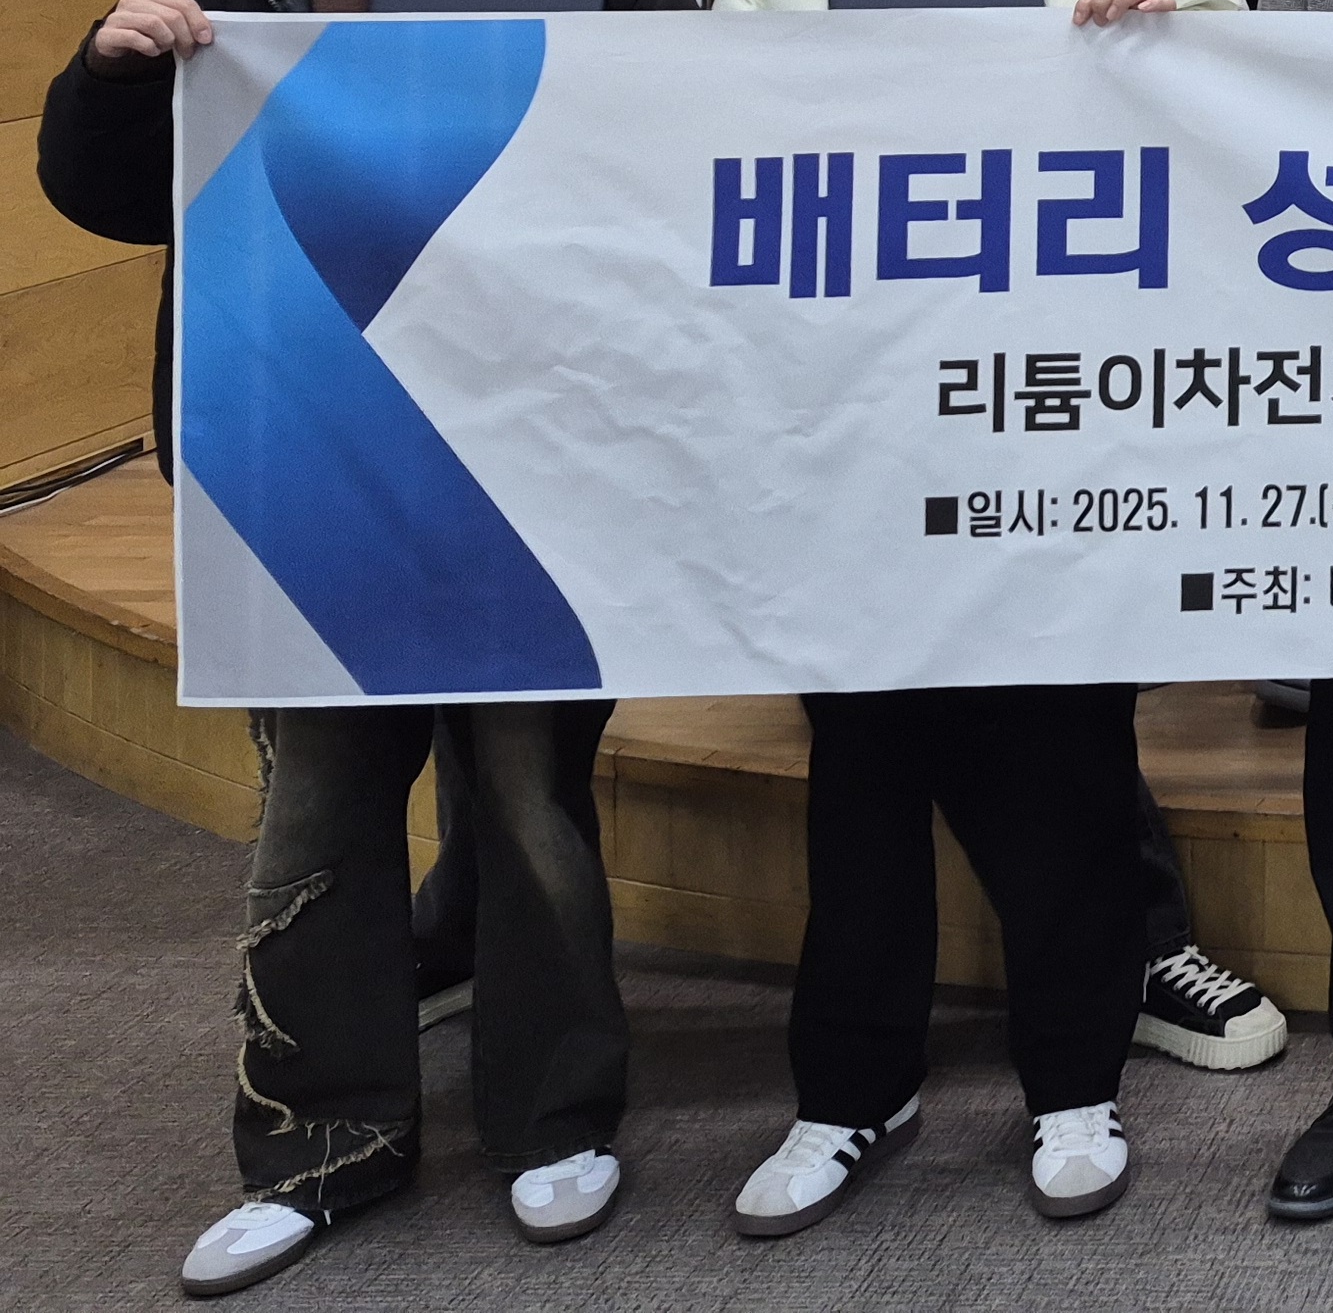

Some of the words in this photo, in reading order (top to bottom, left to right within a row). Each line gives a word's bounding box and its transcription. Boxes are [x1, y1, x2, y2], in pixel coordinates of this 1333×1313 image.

[710, 147, 1169, 298] 배터리
[968, 490, 1057, 537] 일시:
[1074, 488, 1177, 532] 2025.
[1222, 566, 1310, 614] 주최:
